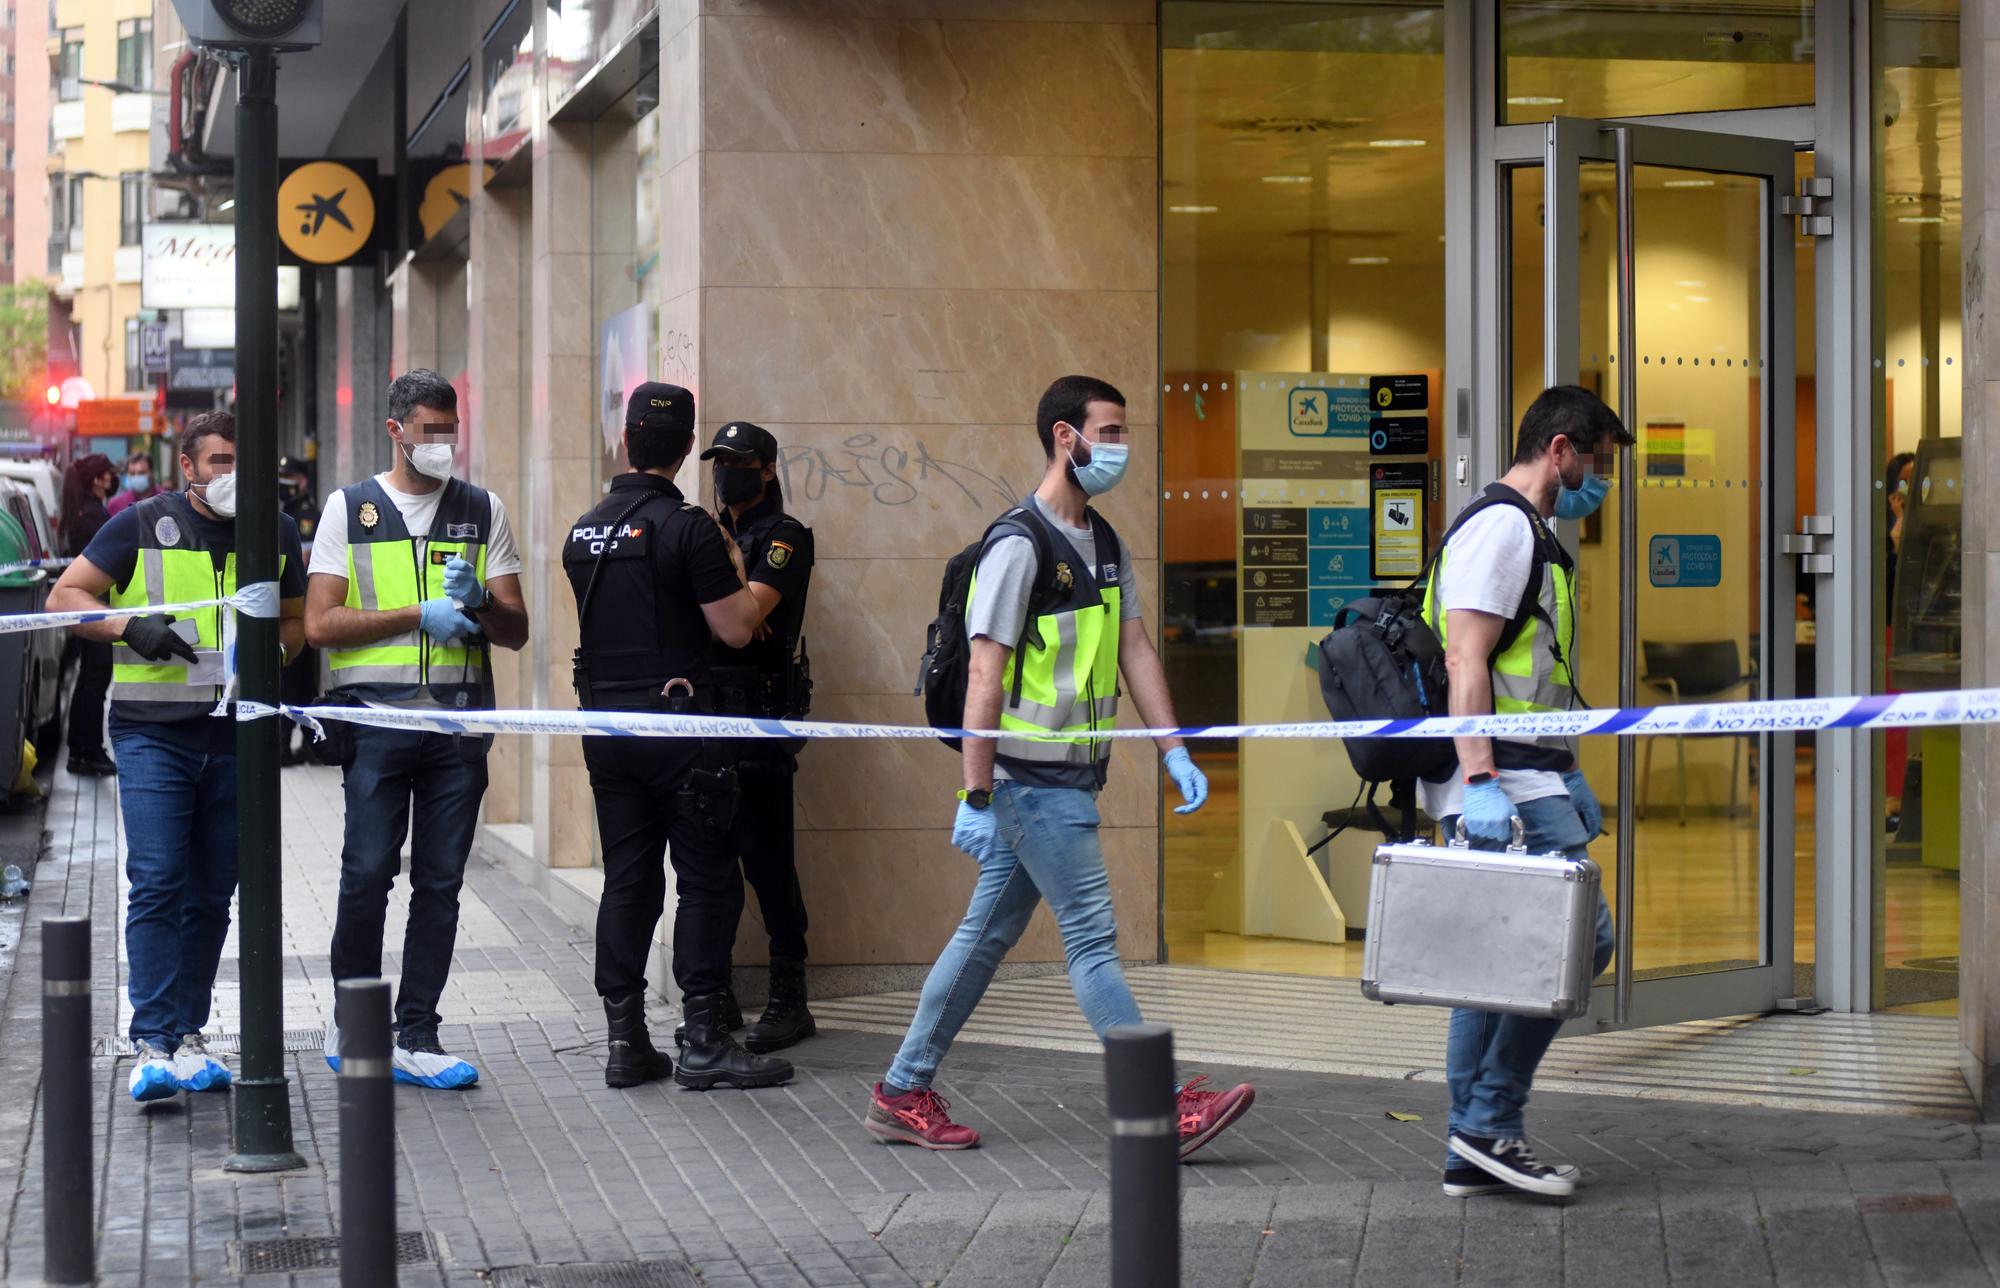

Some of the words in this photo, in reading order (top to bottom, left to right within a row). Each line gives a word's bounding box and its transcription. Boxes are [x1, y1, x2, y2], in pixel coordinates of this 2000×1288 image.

[650, 399, 672, 408] CNP
[1330, 404, 1377, 412] PROTOCO
[1718, 706, 1756, 716] LINEA
[1758, 704, 1776, 715] DE
[1780, 702, 1830, 714] POLICIA
[1963, 709, 1997, 720] NO
[1484, 716, 1521, 726] LINEA
[1522, 715, 1540, 724] DE
[1542, 714, 1590, 724] POLICIA
[1882, 712, 1927, 722] CNP
[1636, 721, 1679, 730] CNP
[1711, 718, 1745, 730] NO
[1750, 716, 1824, 729] PASAR
[1511, 724, 1582, 735] PASAR
